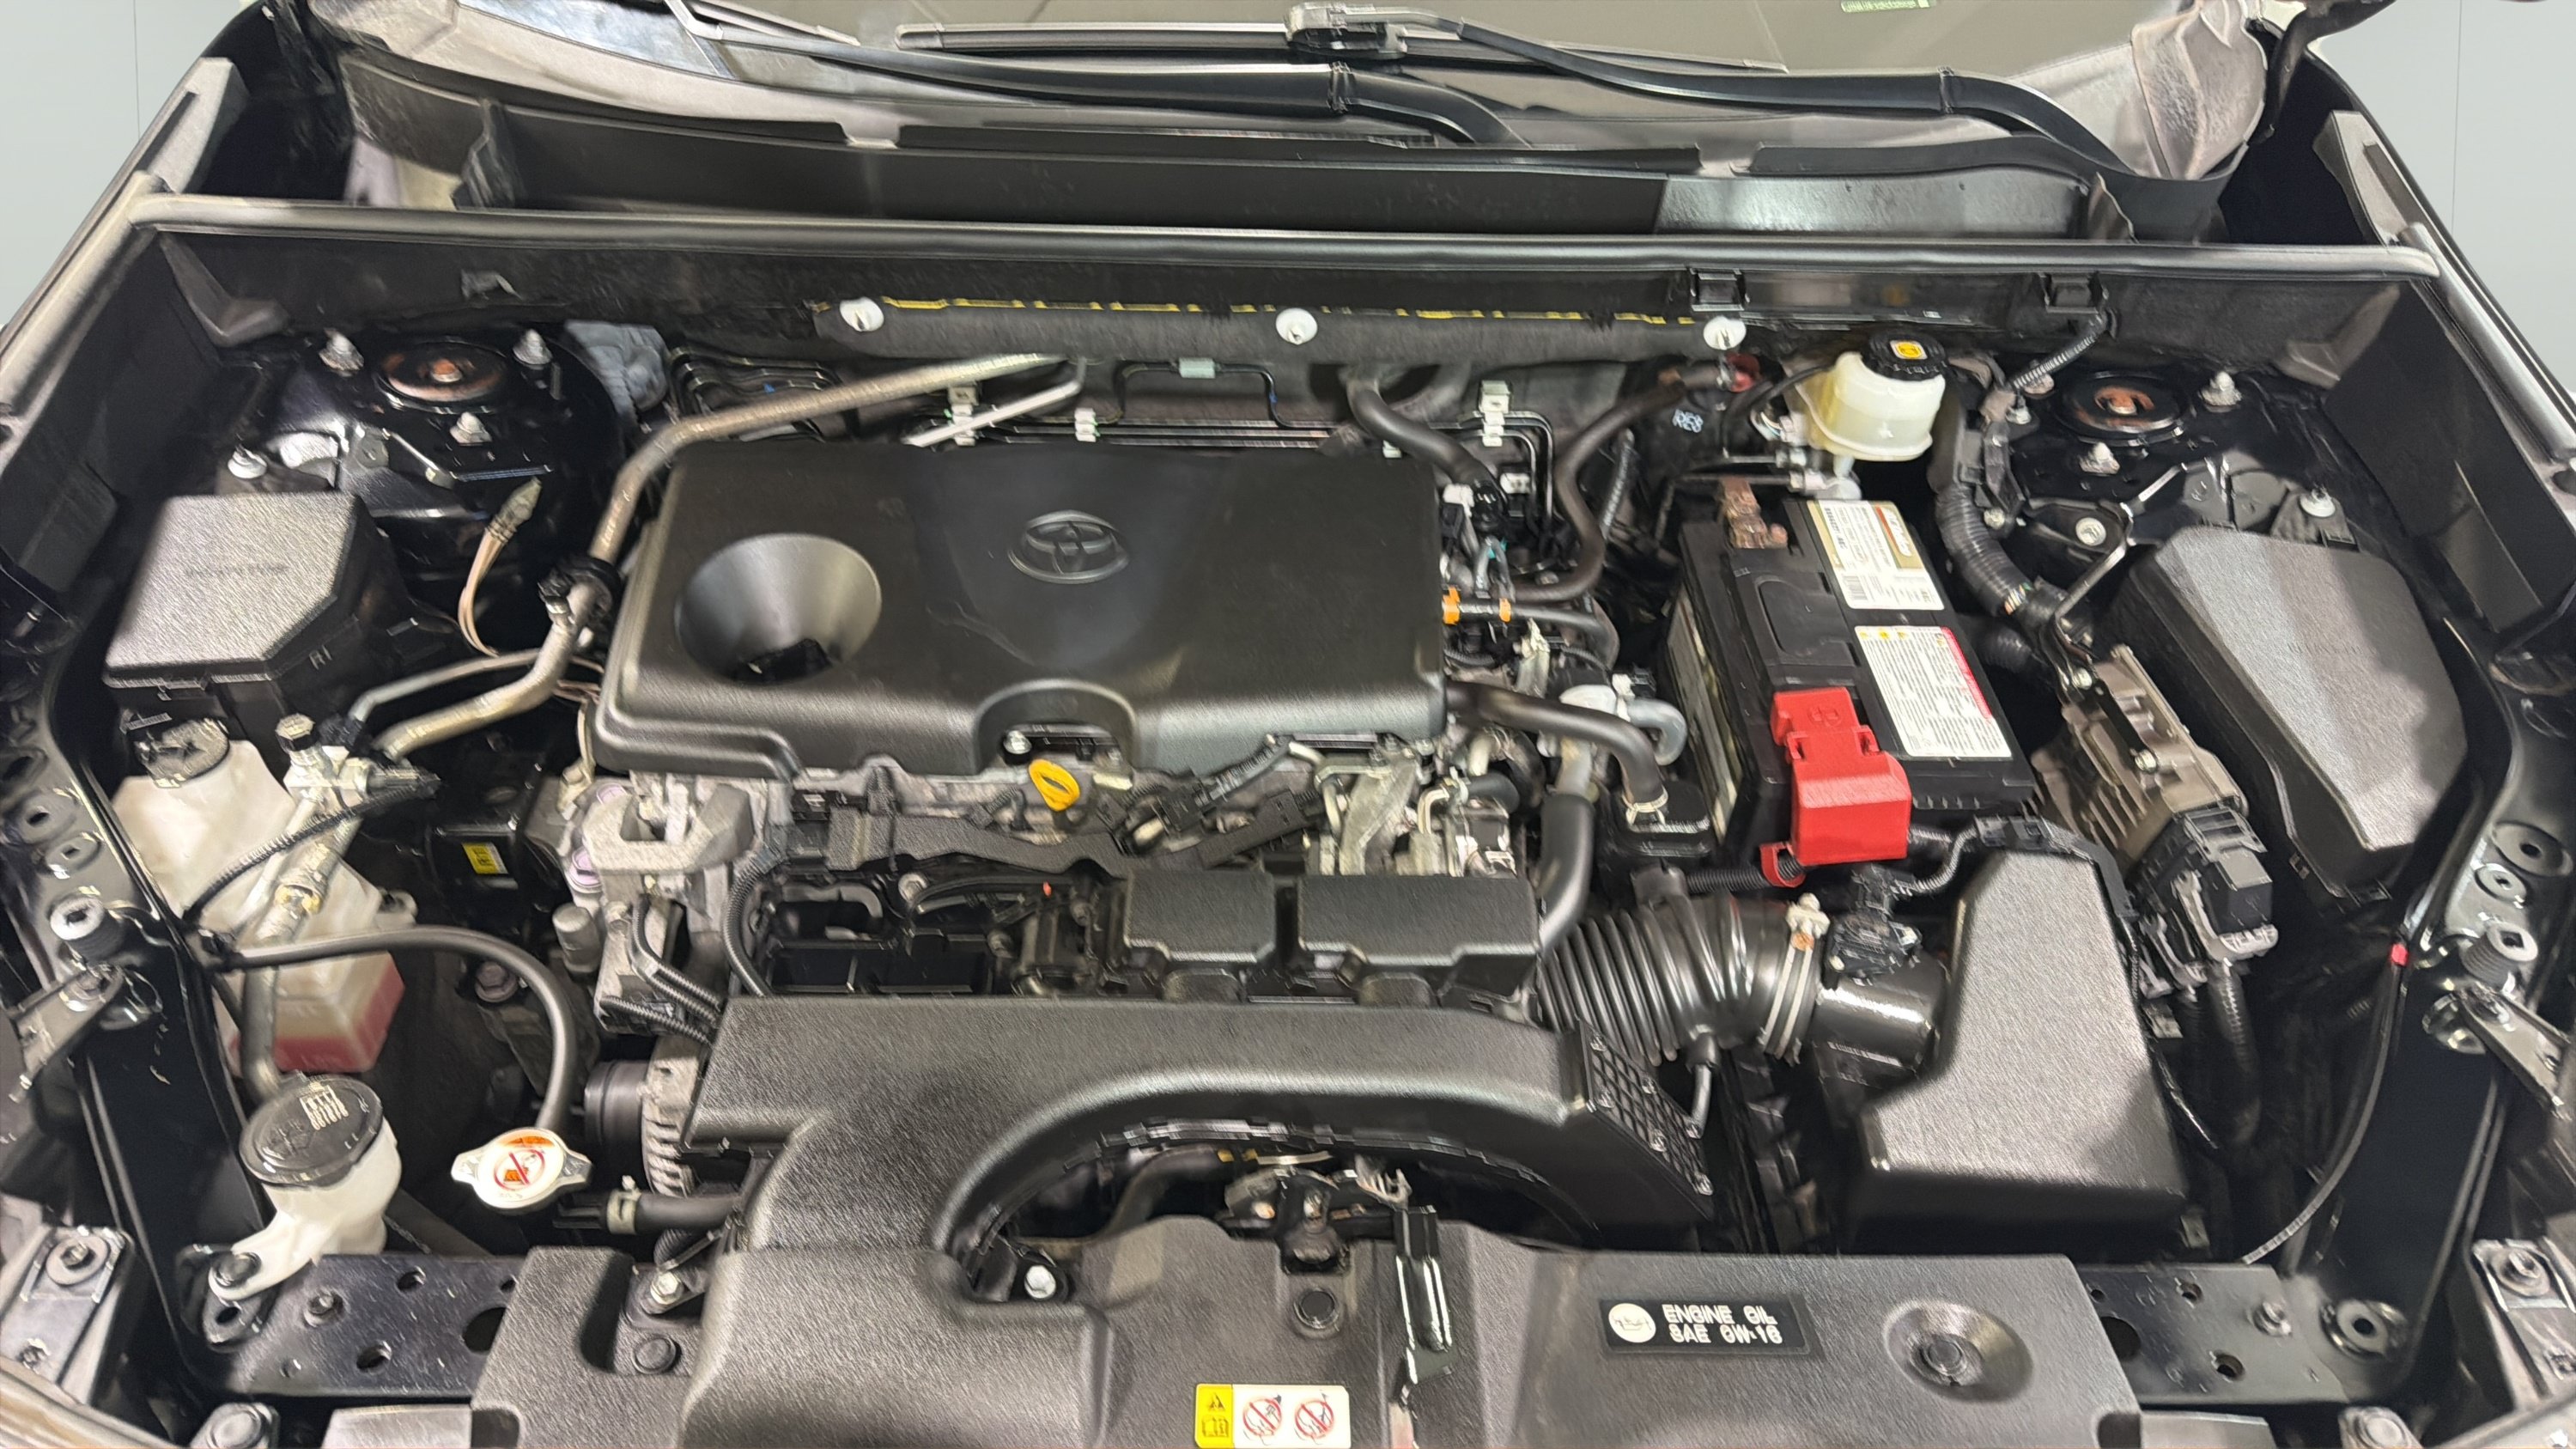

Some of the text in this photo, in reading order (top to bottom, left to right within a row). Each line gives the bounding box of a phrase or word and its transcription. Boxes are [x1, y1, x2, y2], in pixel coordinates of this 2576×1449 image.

[1662, 1304, 1778, 1325] ENGINE OIL
[1668, 1324, 1783, 1344] SAE 0W-16
